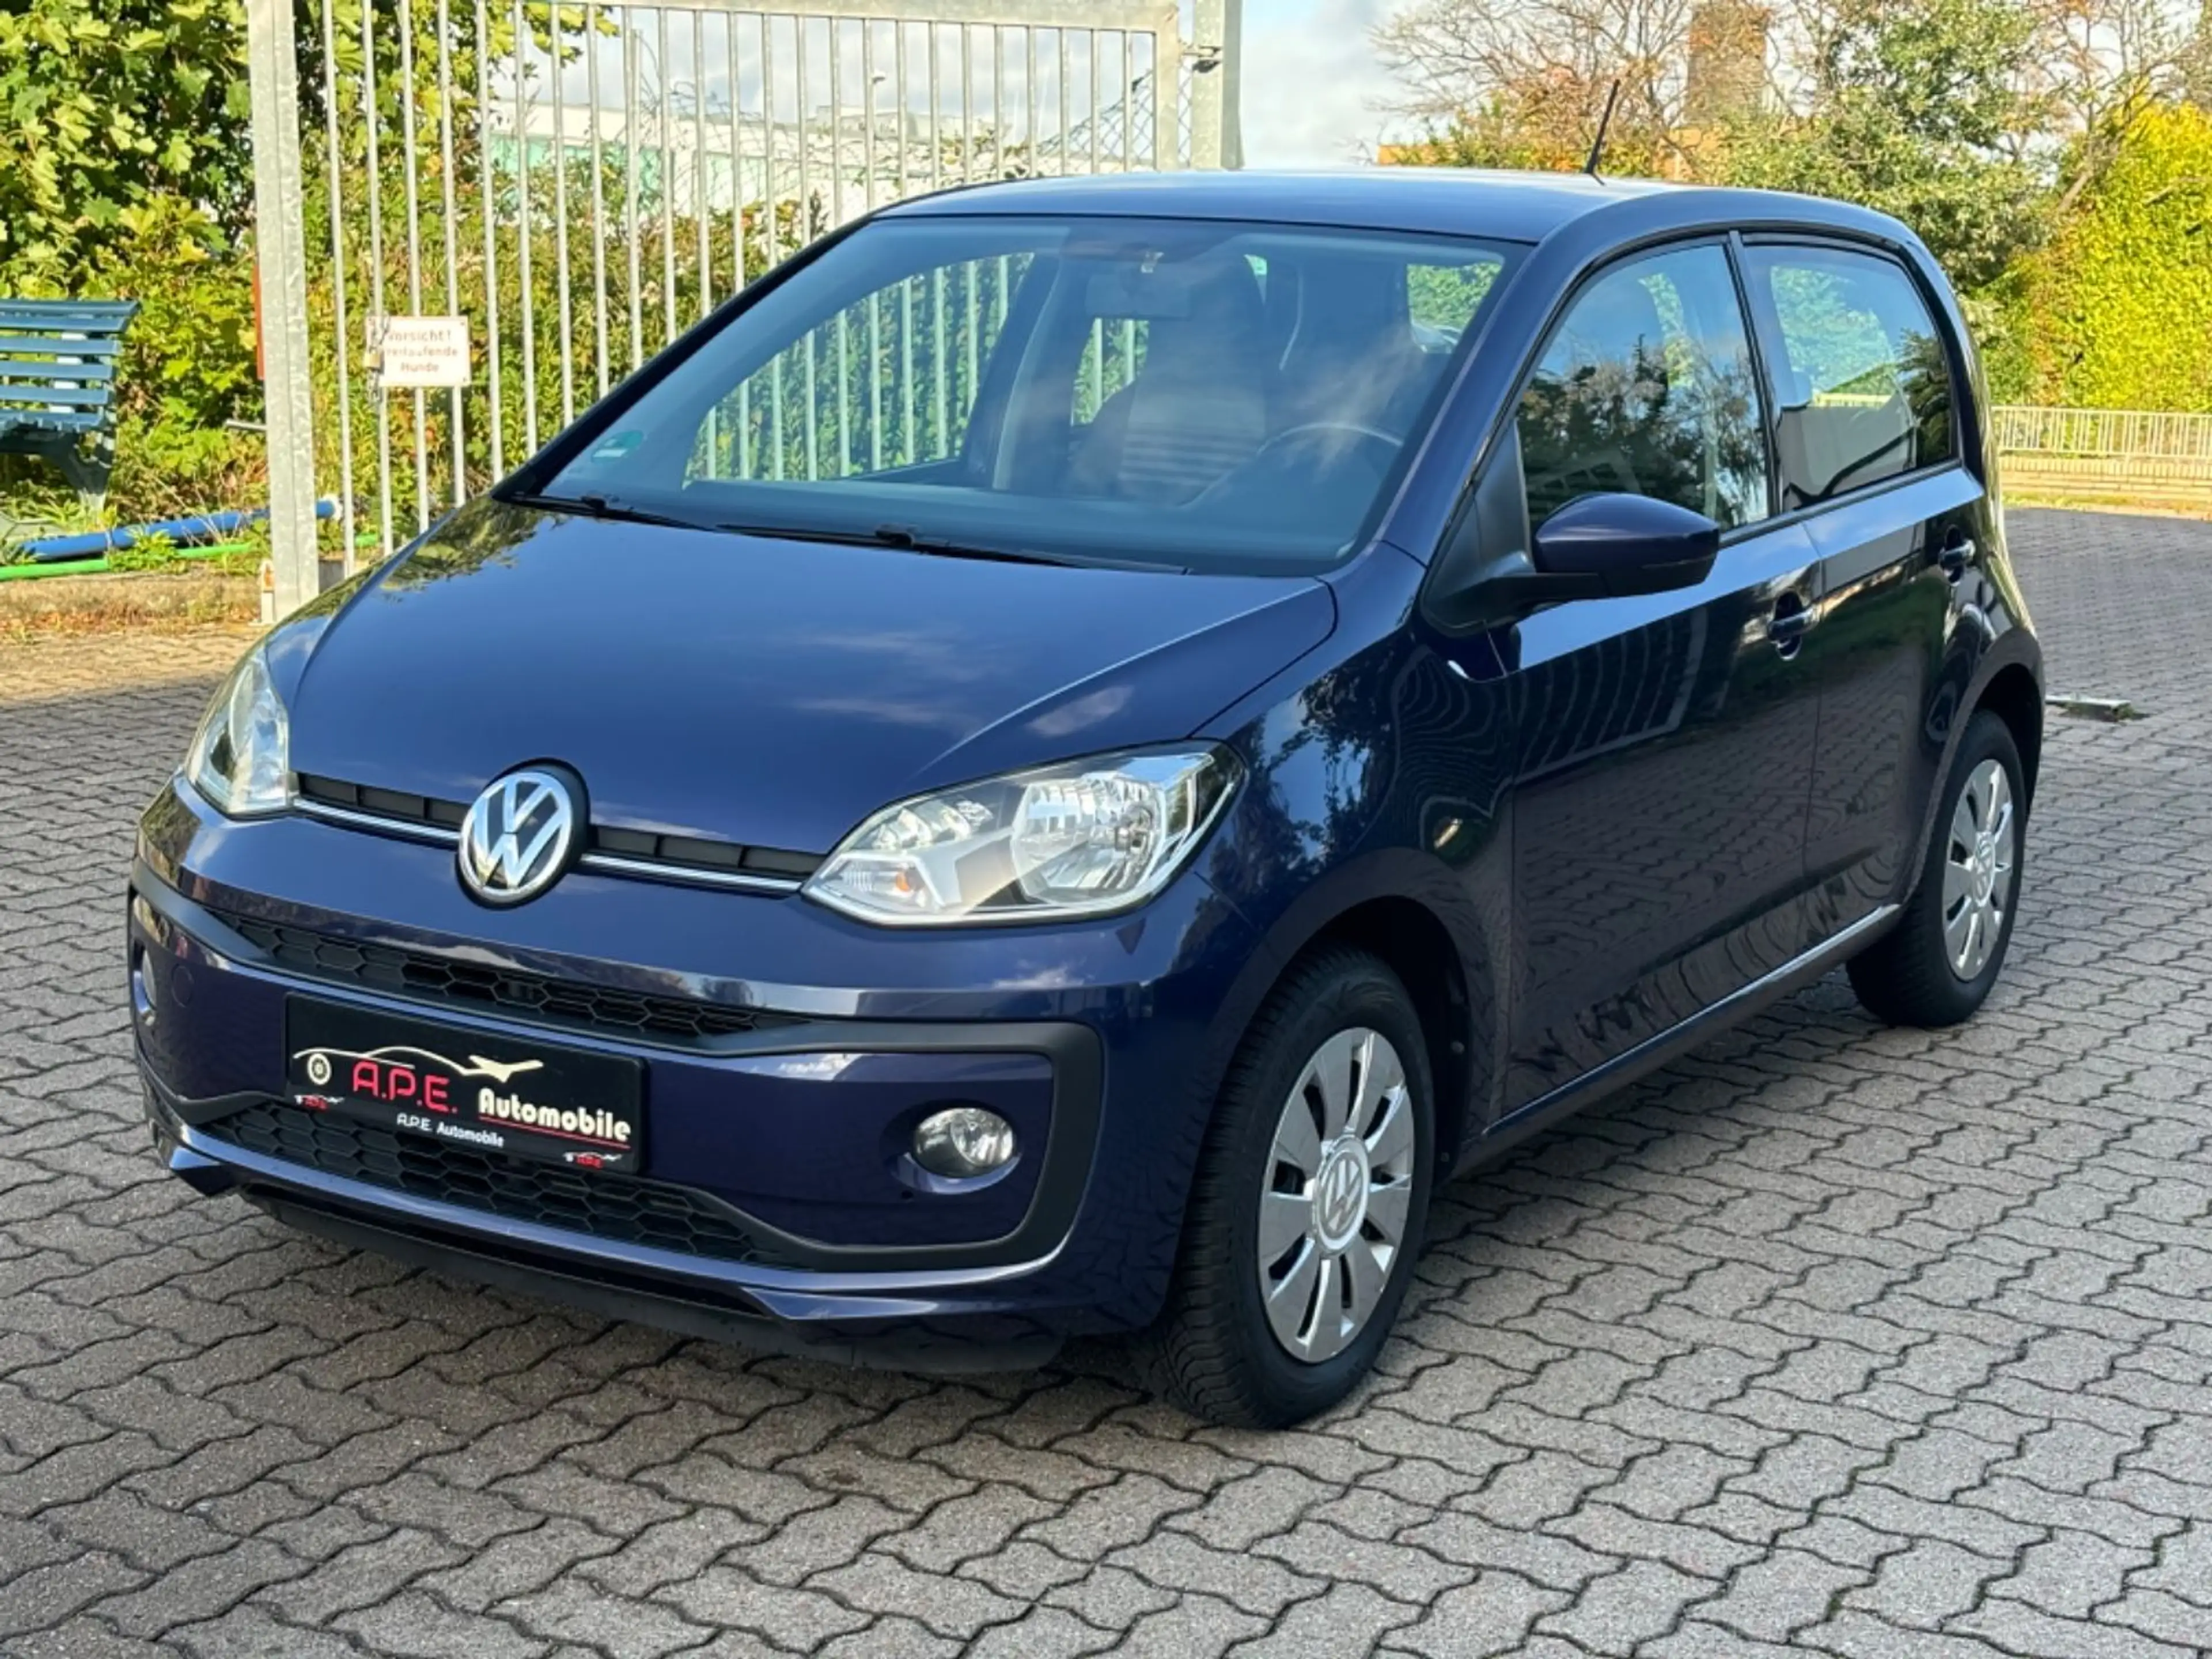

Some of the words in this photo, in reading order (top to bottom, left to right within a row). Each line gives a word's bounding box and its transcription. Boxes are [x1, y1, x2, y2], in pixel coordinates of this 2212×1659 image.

[400, 361, 440, 373] Hunde
[460, 772, 572, 900] VW
[436, 1121, 505, 1148] Automobile
[478, 1087, 631, 1142] Automobile
